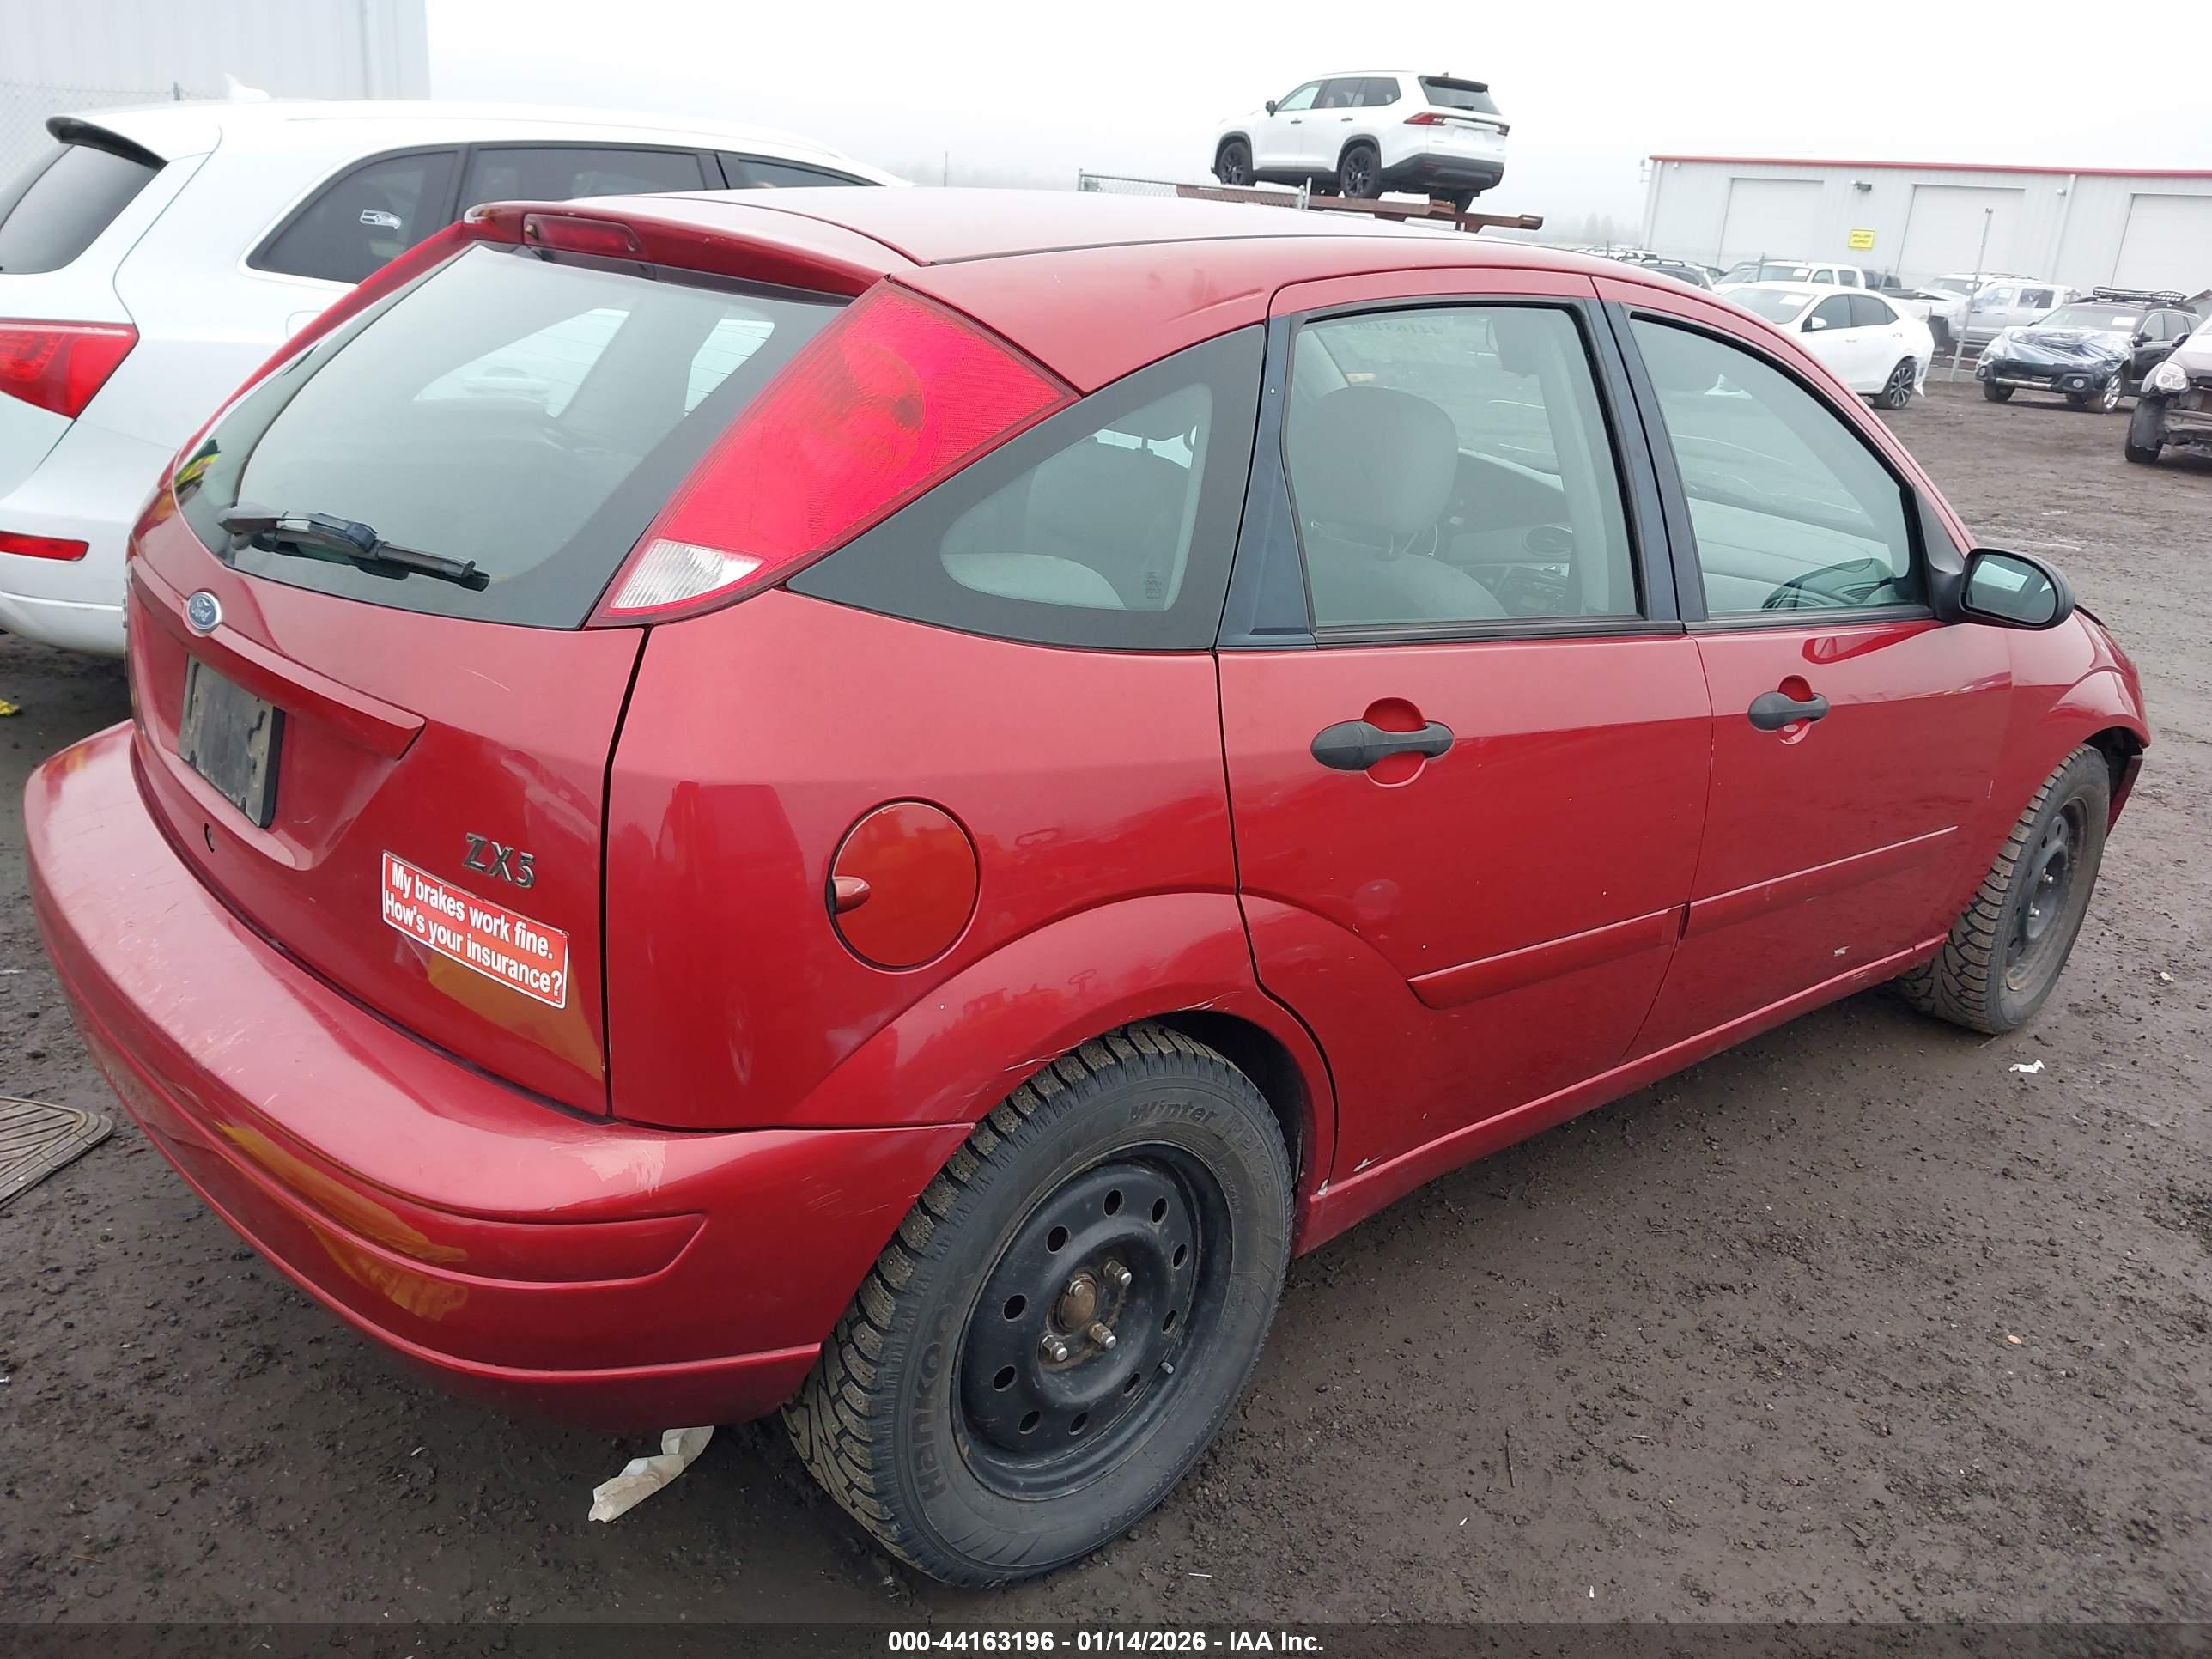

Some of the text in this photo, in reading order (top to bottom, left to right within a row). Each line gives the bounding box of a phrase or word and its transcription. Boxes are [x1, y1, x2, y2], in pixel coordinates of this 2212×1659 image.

[462, 831, 536, 890] ZX5
[385, 890, 562, 997] How's your insurance?
[392, 861, 553, 960] My brakes work fine.
